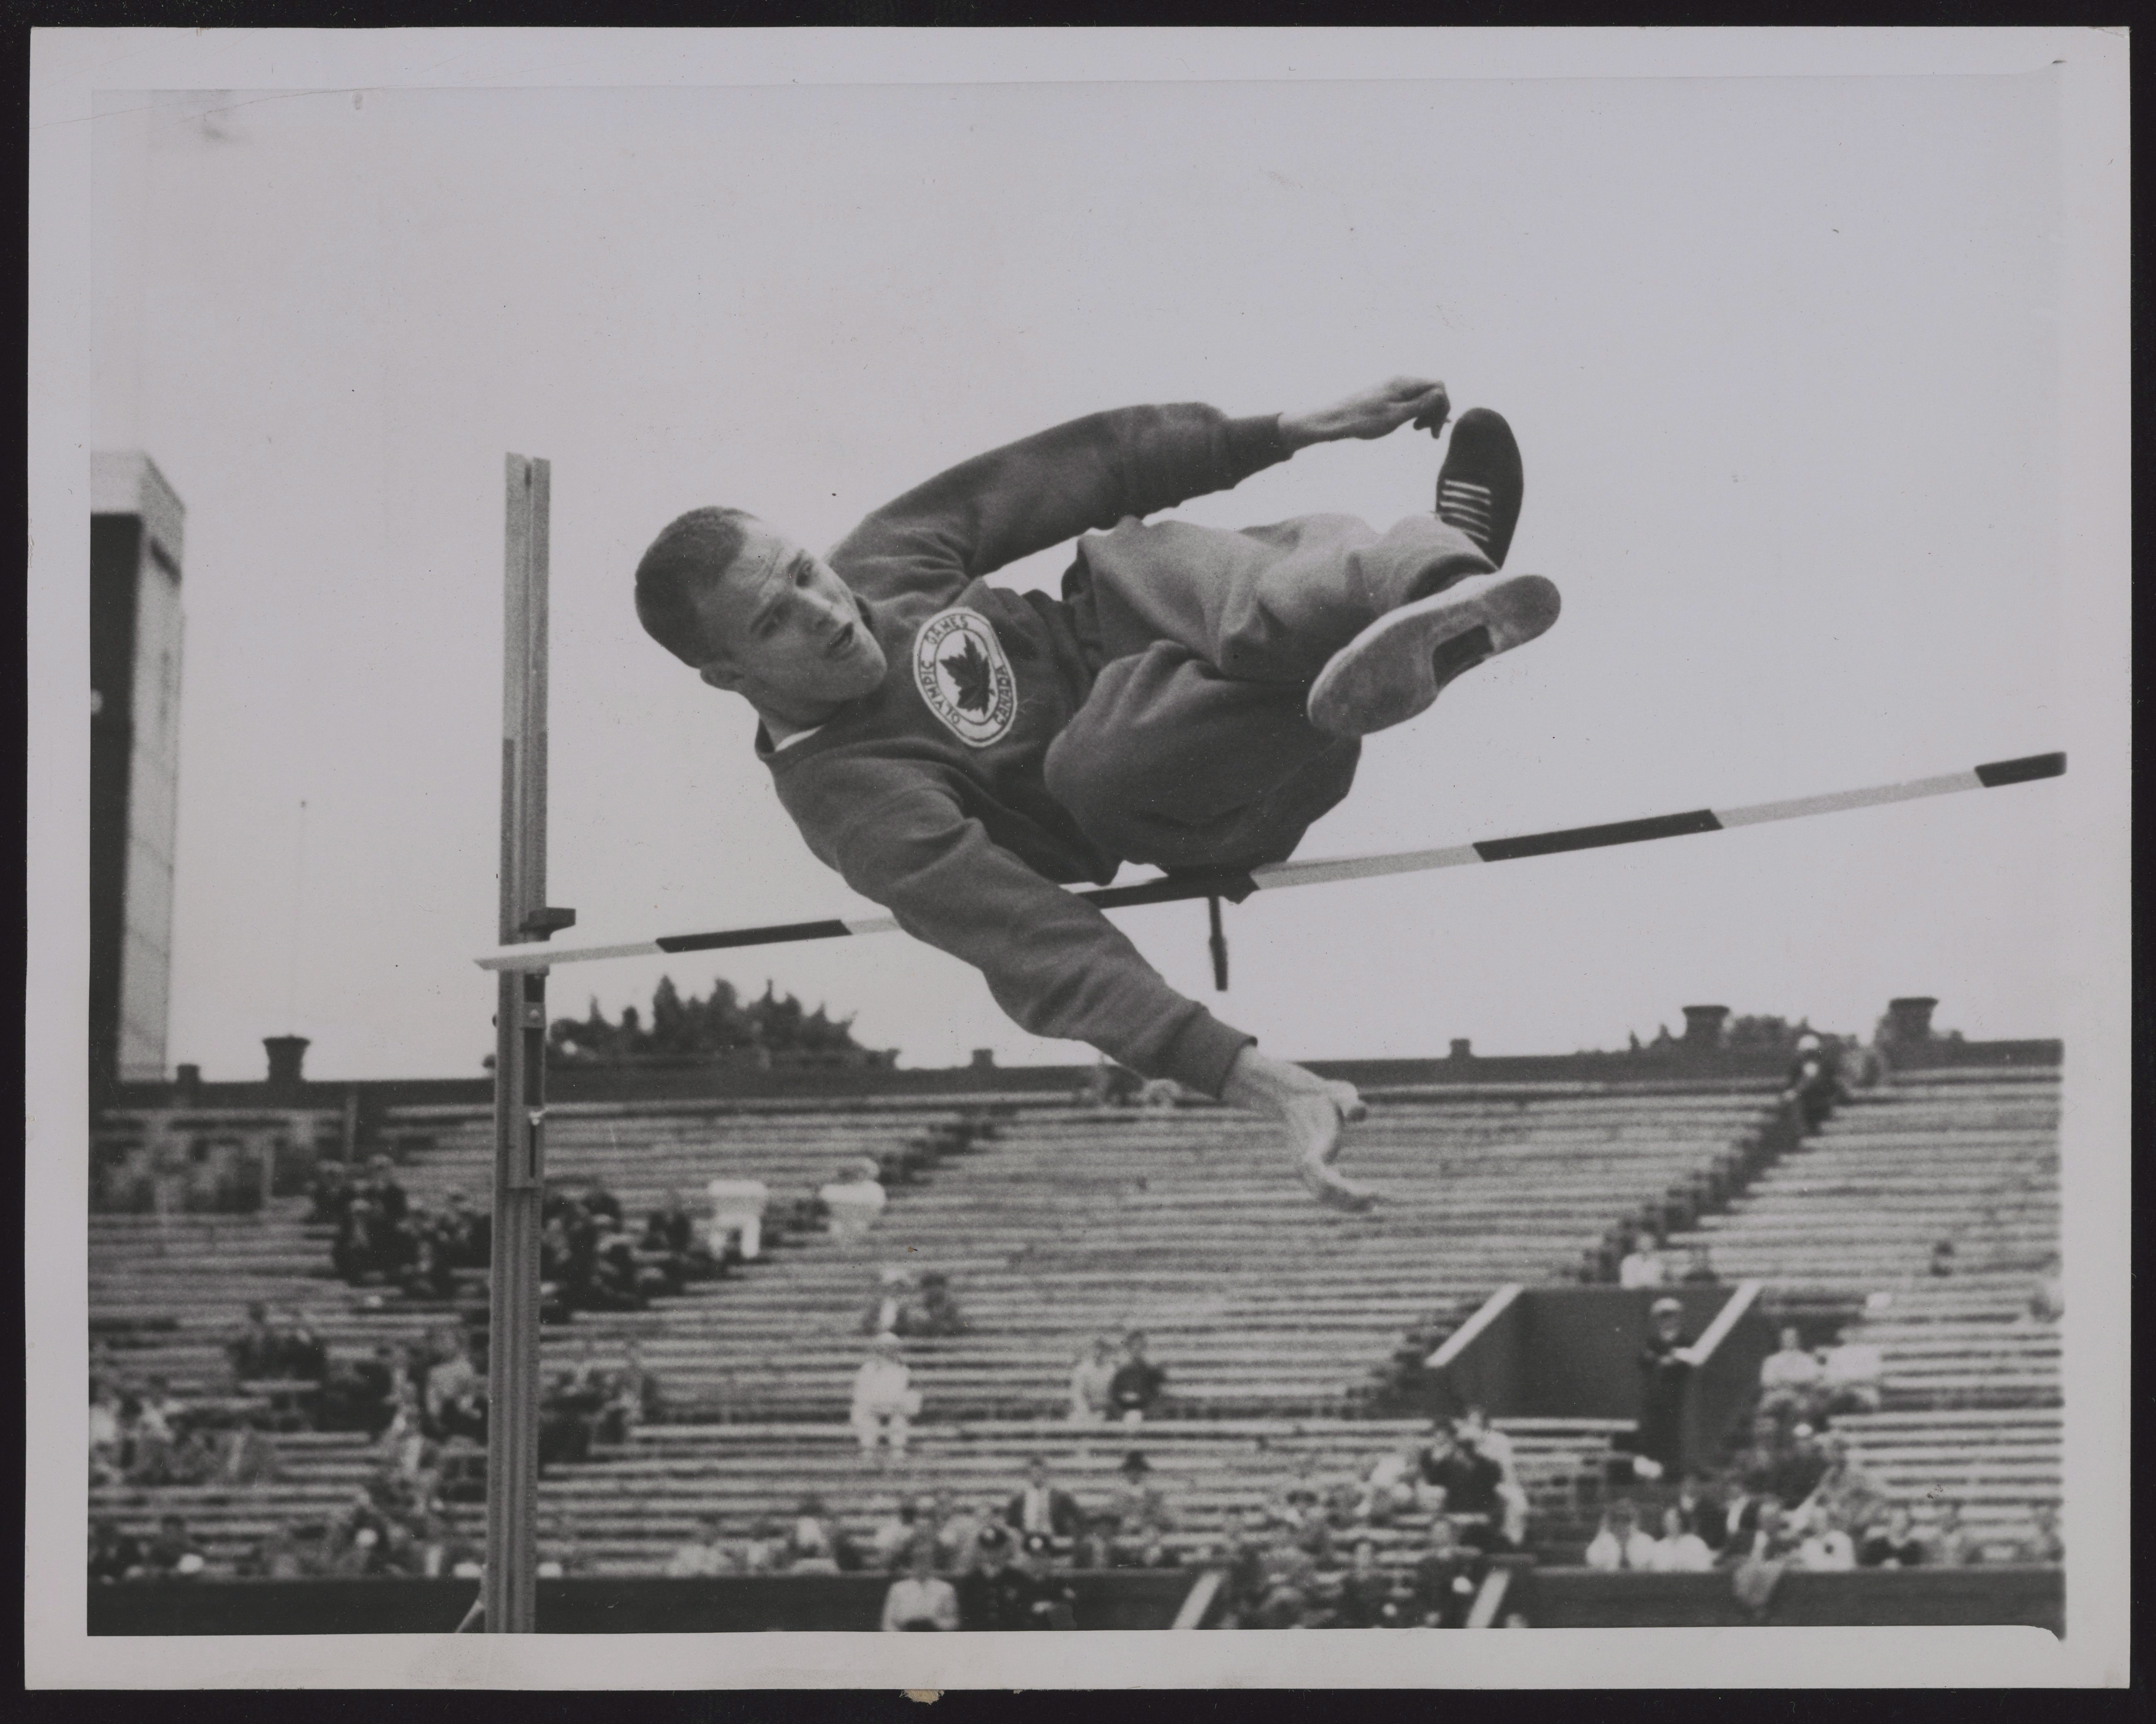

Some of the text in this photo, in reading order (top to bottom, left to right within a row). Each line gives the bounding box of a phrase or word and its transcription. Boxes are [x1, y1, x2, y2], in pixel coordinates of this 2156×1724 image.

[920, 615, 969, 725] OLYMPIC GAMES
[995, 665, 1012, 725] CANADA
